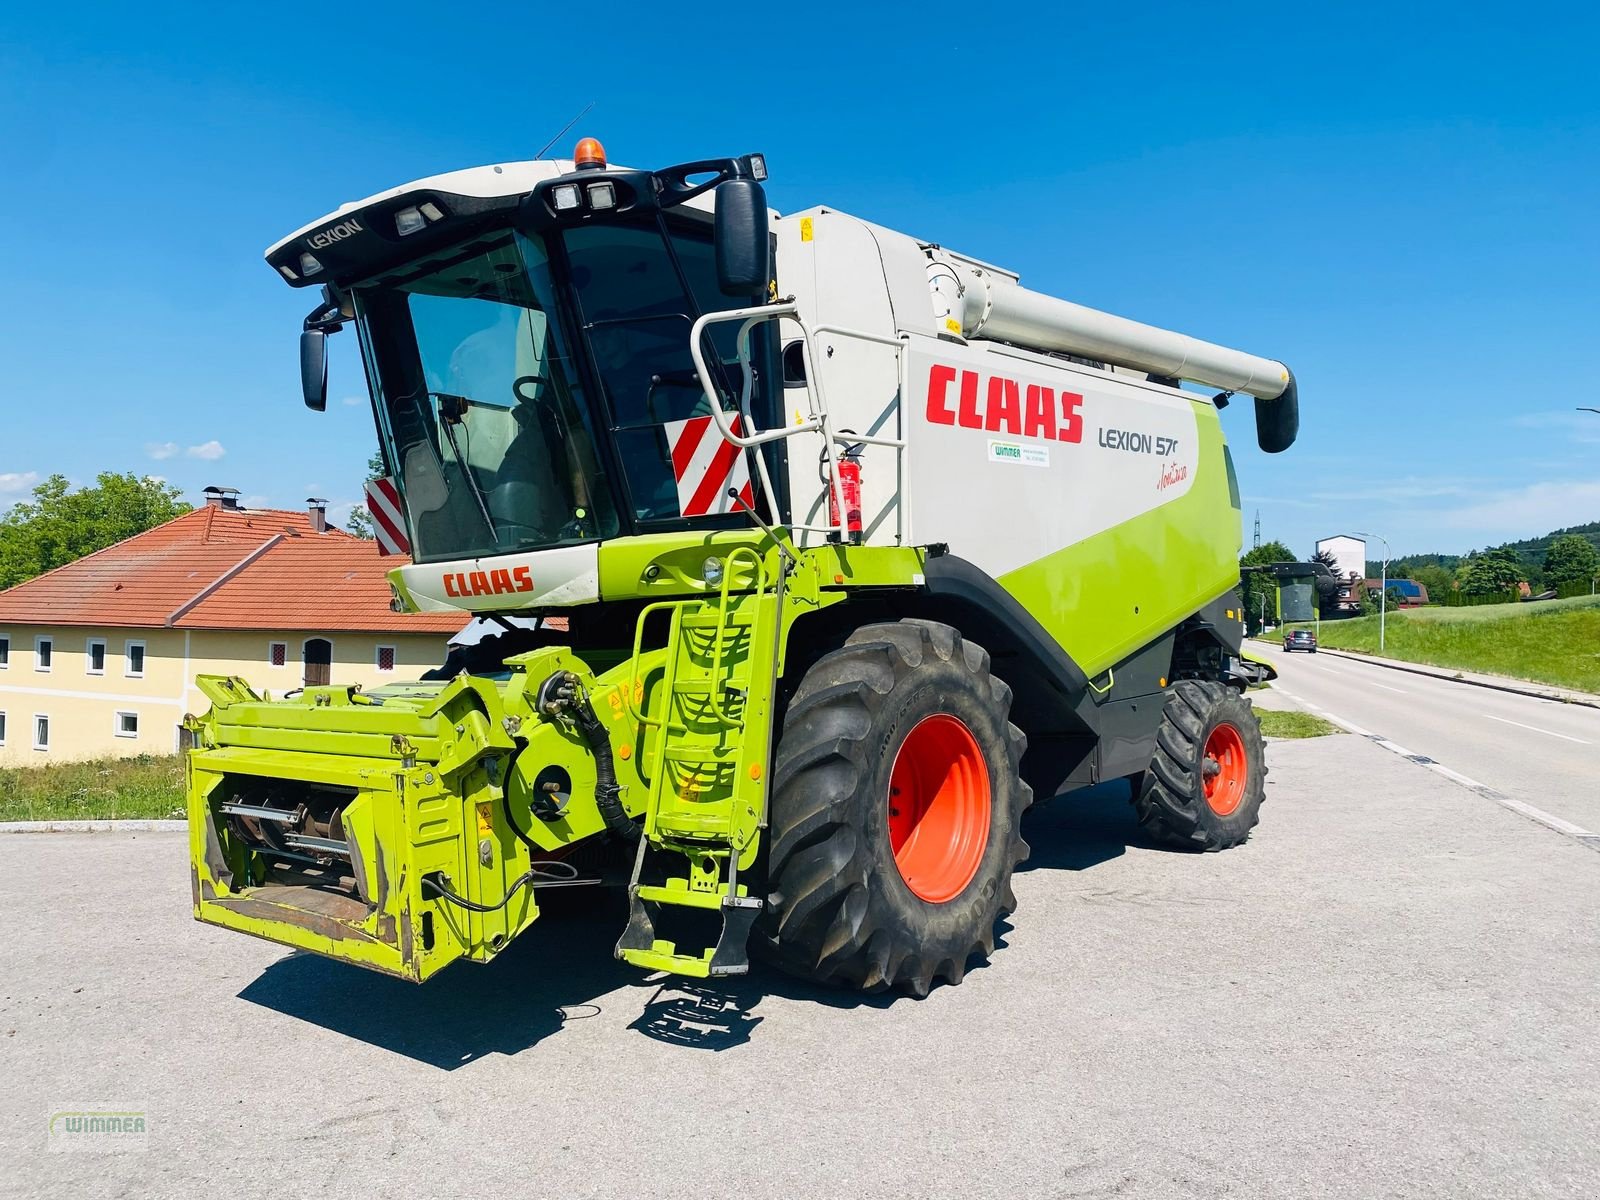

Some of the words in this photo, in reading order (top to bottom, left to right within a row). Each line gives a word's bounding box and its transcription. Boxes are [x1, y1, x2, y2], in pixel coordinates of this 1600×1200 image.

[307, 218, 364, 250] LEXION
[926, 364, 1083, 444] CLAAS
[1098, 427, 1152, 454] LEXION
[442, 566, 534, 598] CLAAS
